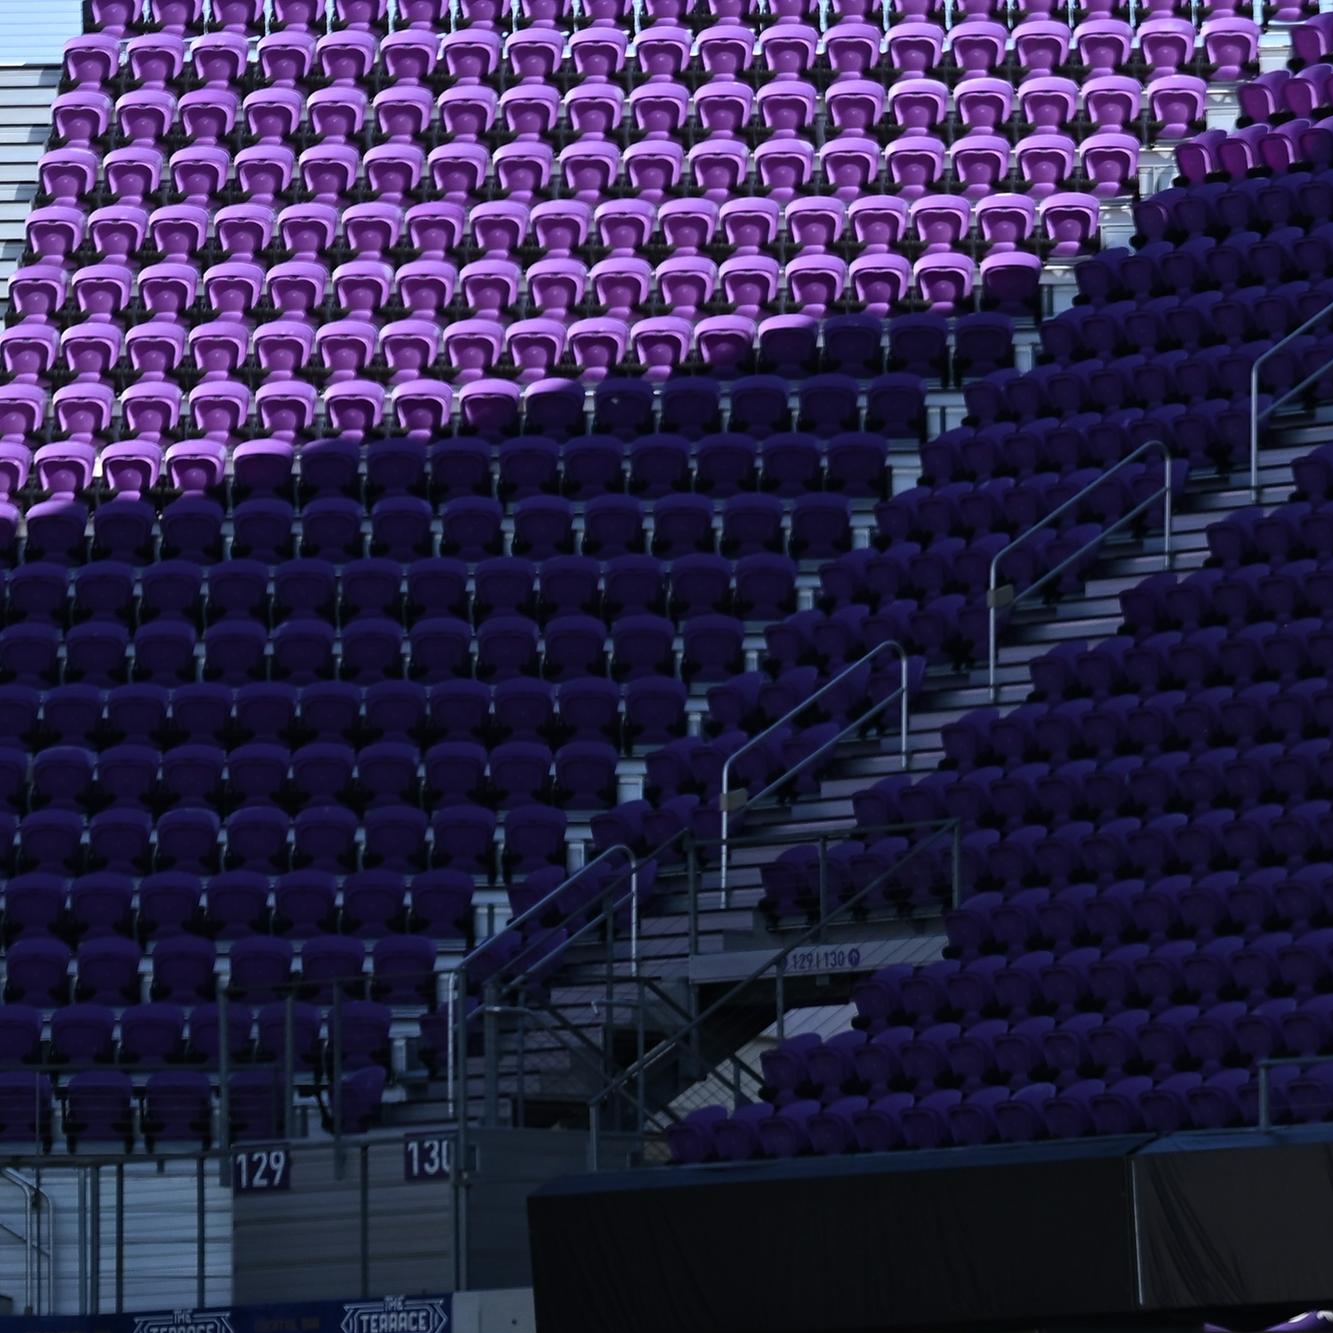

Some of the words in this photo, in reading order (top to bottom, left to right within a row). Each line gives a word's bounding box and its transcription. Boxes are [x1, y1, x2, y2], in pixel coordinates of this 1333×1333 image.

[792, 952, 813, 969] 129
[824, 950, 845, 968] 130
[236, 1151, 285, 1188] 129
[360, 1311, 427, 1333] TERRACE
